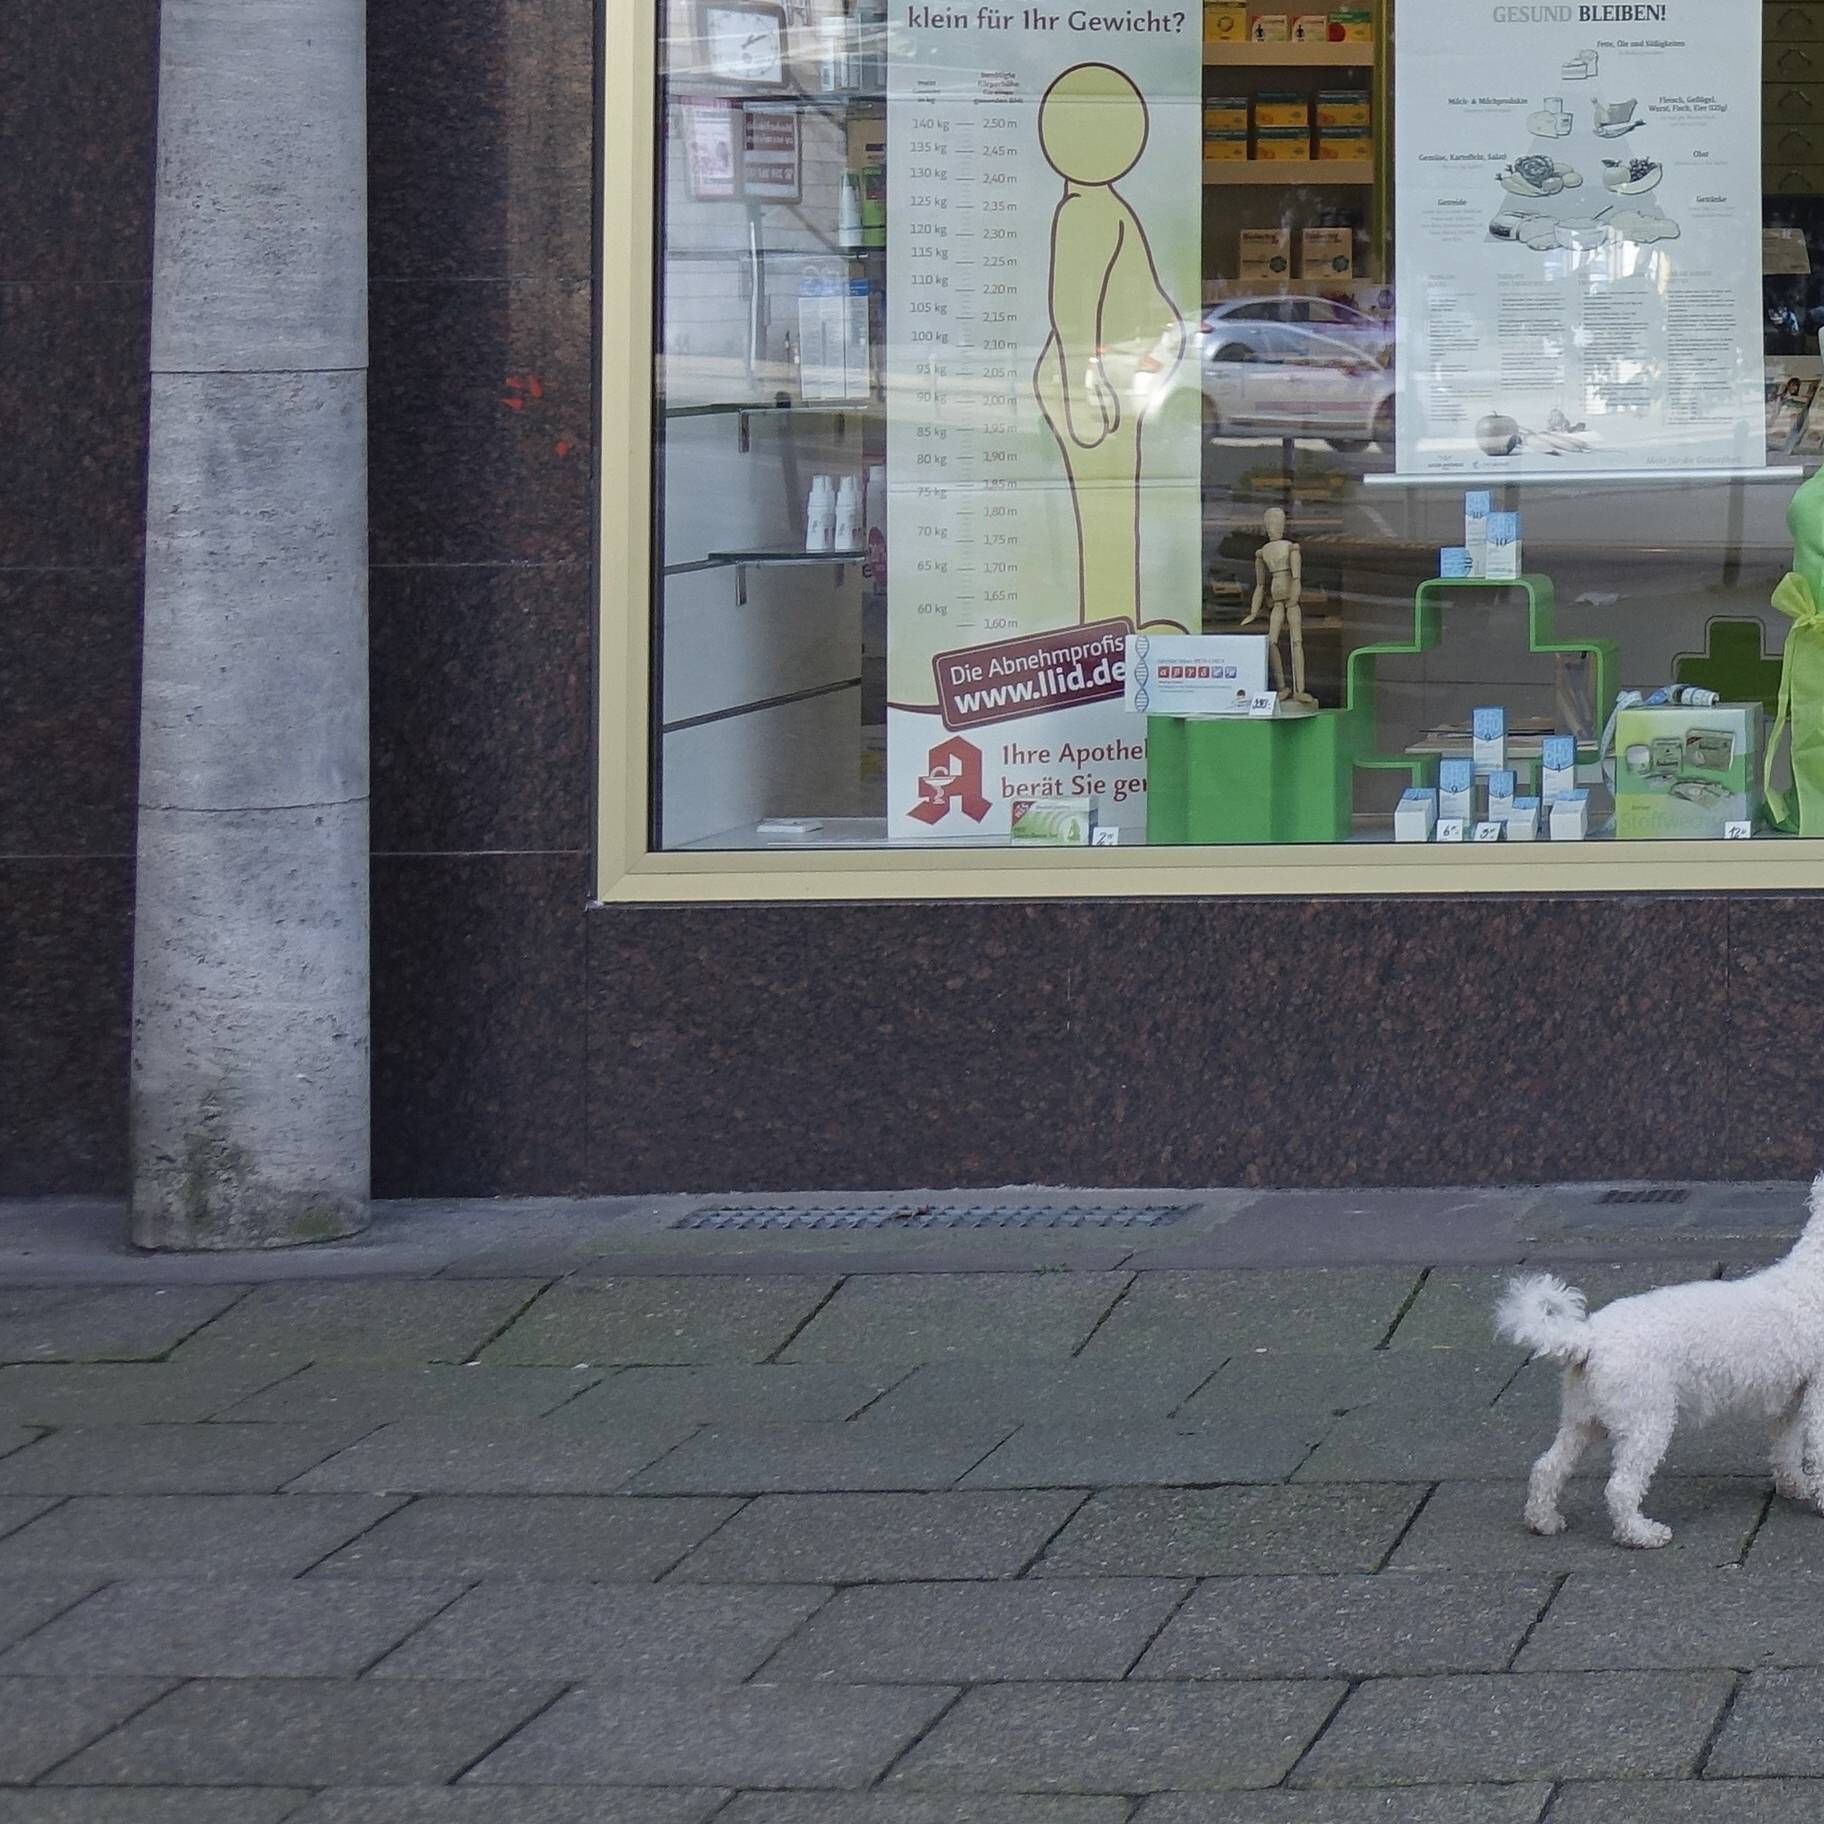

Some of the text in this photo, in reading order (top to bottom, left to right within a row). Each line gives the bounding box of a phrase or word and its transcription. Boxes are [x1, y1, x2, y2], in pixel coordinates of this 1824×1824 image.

[907, 6, 1186, 33] klein für Ihr Gewicht?
[1493, 4, 1666, 23] GESUND BLEIBEN!
[912, 118, 950, 132] 140 kg
[910, 141, 947, 155] 135 kg
[910, 195, 947, 209] 125 kg
[910, 224, 947, 237] 120 kg
[1007, 286, 1017, 294] m
[910, 302, 947, 315] 105 kg
[911, 331, 948, 344] 100 kg
[916, 426, 947, 439] 85 kg
[916, 454, 947, 466] 80 kg
[917, 560, 947, 573] 65 kg
[917, 603, 947, 616] 60 kg
[950, 635, 1125, 686] Die Abnehmprofis
[953, 657, 1127, 715] www.llid.de
[1002, 742, 1051, 765] Ihre
[1001, 775, 1064, 799] berät
[1071, 774, 1106, 795] Sie
